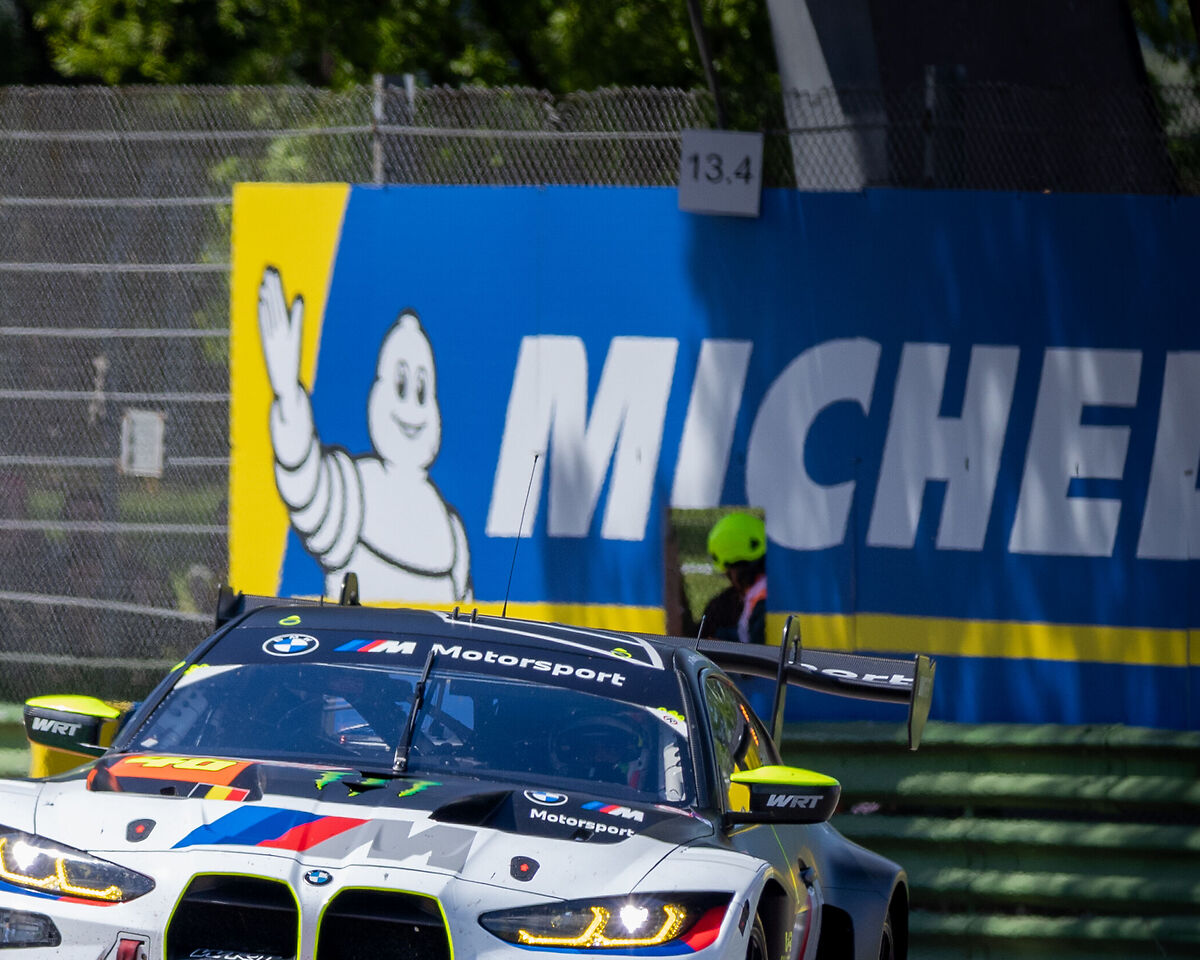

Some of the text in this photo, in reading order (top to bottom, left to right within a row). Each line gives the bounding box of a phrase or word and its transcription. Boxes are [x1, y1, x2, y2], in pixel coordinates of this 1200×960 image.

[687, 153, 753, 185] 13.4
[430, 643, 627, 687] Motorsport
[32, 716, 82, 737] WRT
[766, 794, 824, 809] WRT
[529, 808, 636, 837] Motorsport
